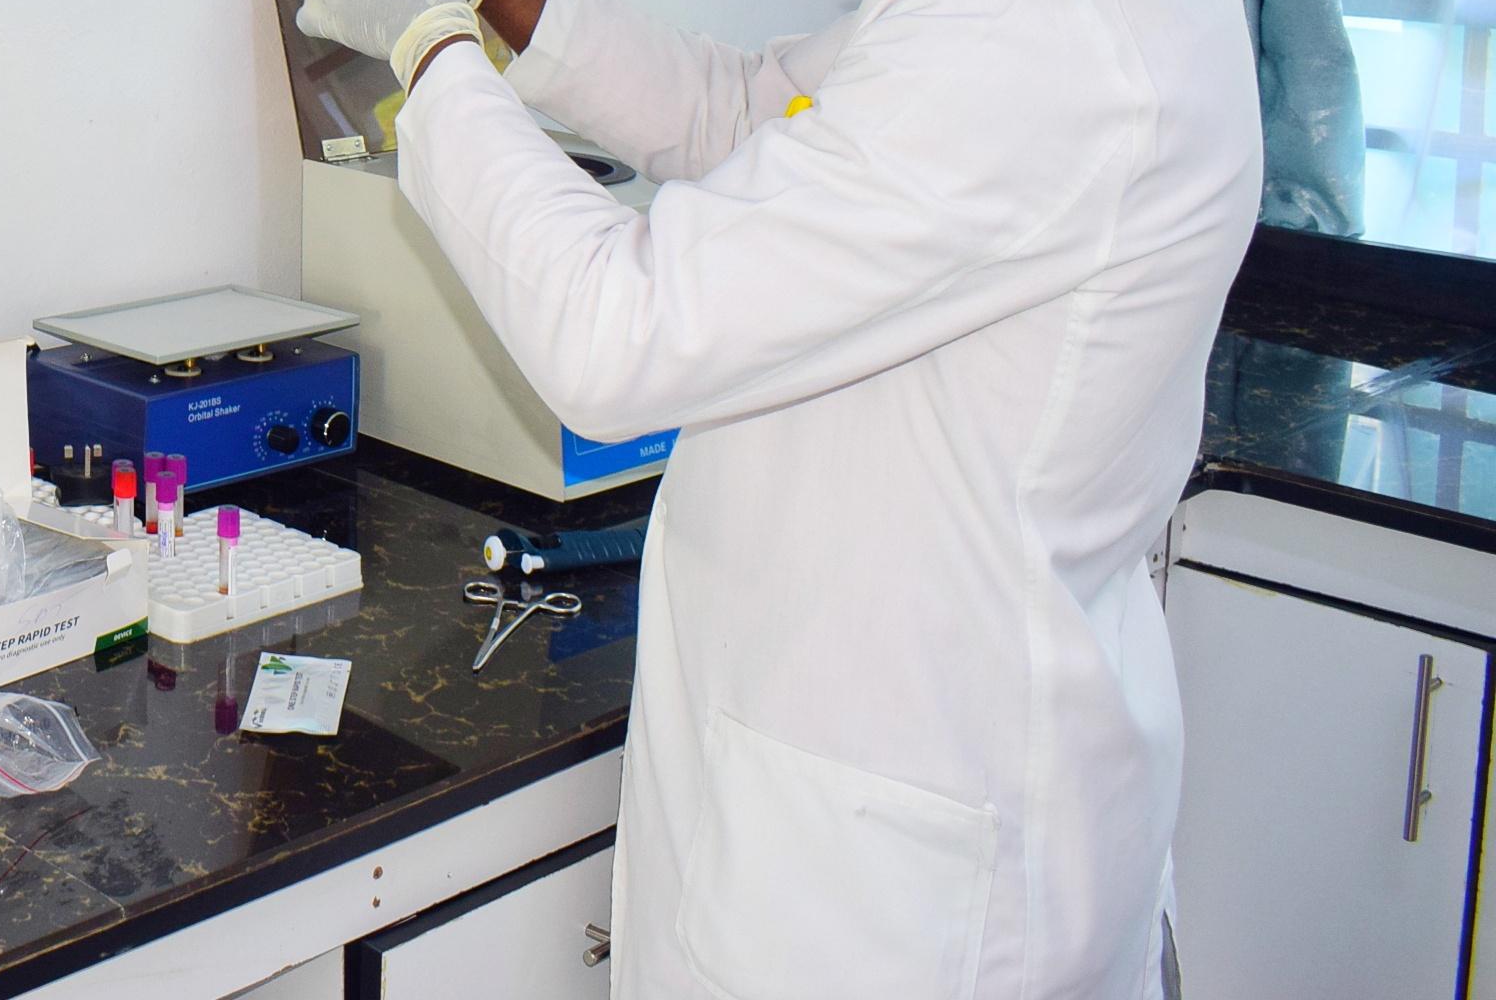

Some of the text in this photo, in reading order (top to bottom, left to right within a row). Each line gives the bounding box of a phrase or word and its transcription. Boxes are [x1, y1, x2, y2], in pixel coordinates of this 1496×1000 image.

[188, 396, 222, 412] KJ-201BS
[188, 404, 241, 423] Orbital Shaker
[639, 441, 667, 458] MADE
[17, 625, 51, 646] RAPID
[54, 615, 81, 633] TEST
[113, 628, 133, 642] DEVICE
[6, 643, 39, 659] diagnostic
